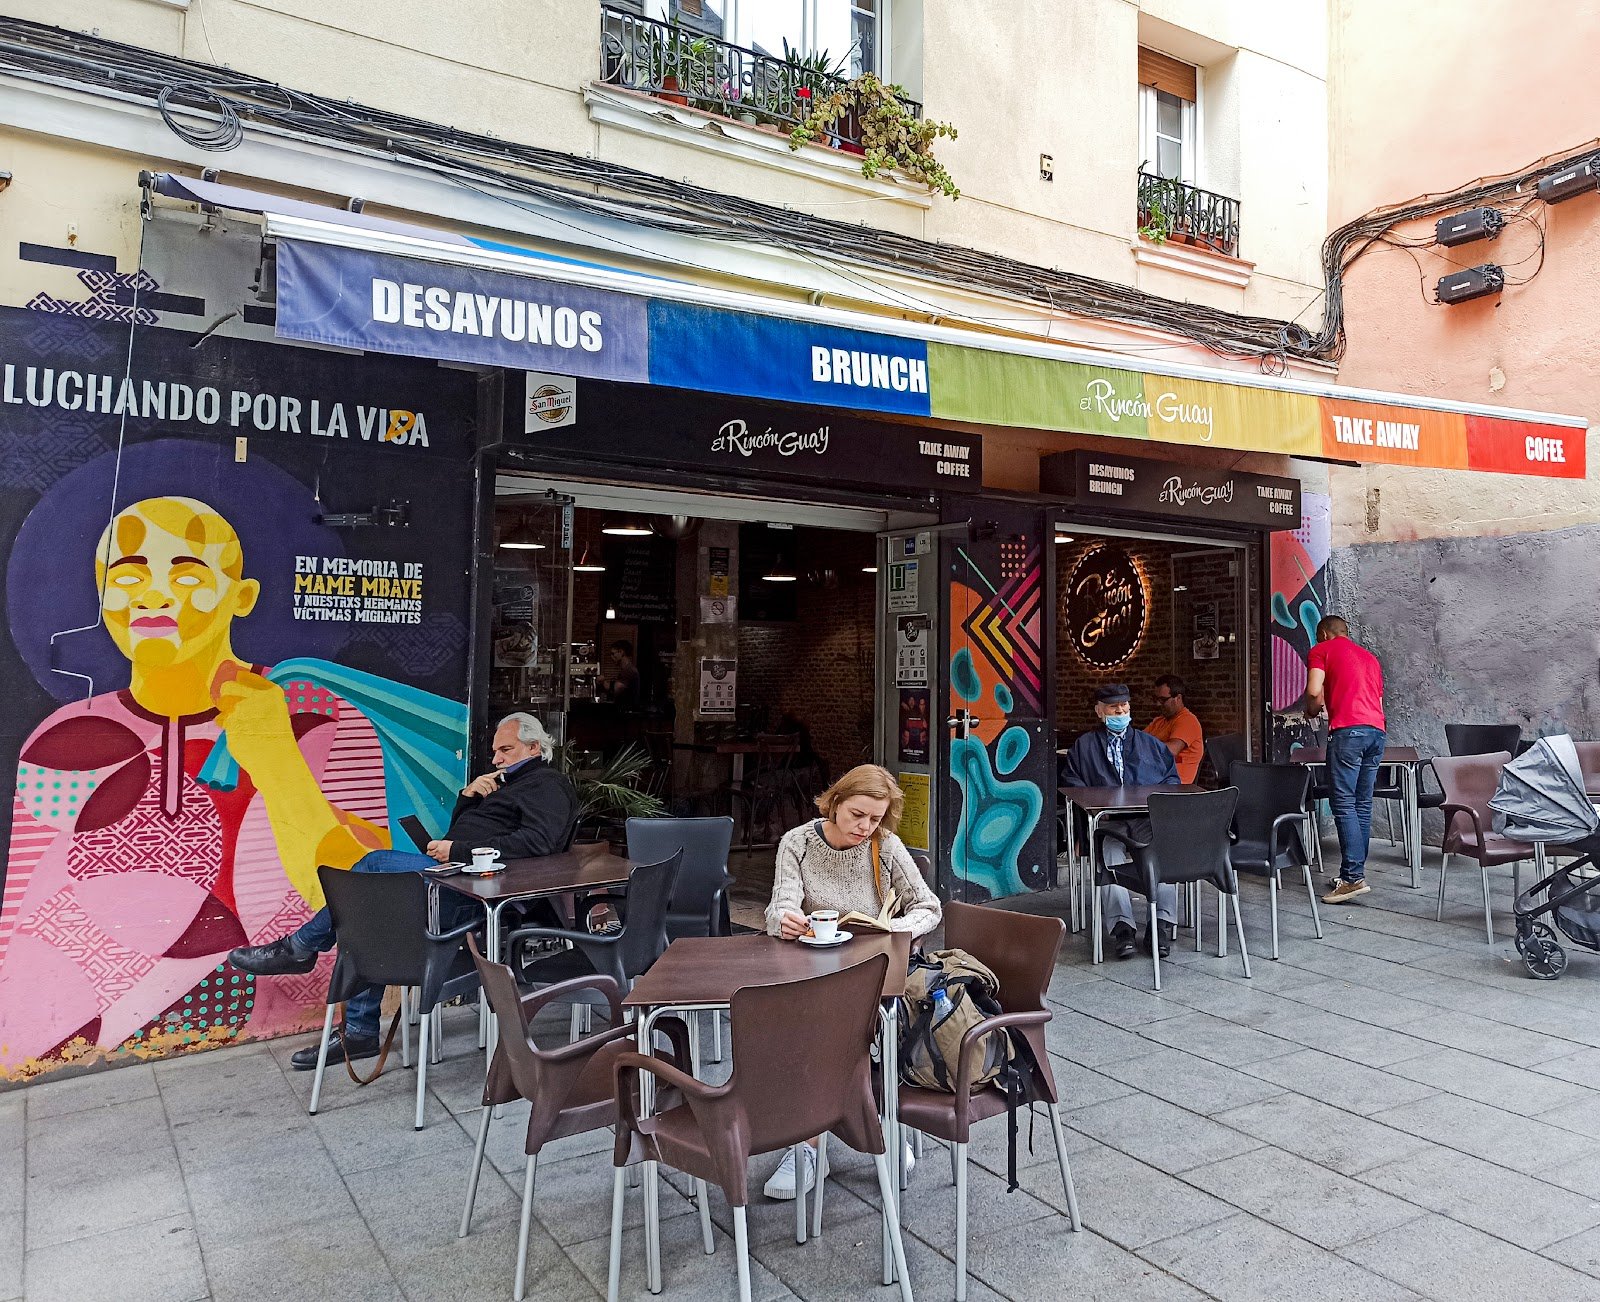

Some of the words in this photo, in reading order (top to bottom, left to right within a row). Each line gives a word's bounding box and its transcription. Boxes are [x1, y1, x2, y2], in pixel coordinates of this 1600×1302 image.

[372, 279, 603, 351] DESAYUNOS
[812, 346, 928, 393] BRUNCH
[4, 364, 220, 424] LUCHANDO
[230, 391, 301, 433] POR
[310, 400, 349, 438] LA
[530, 399, 547, 412] San
[547, 395, 571, 407] Miguel
[1079, 396, 1091, 411] El
[1086, 379, 1153, 422] Rincón
[1156, 392, 1213, 442] Guay
[711, 437, 725, 451] El
[719, 419, 780, 456] Rincón
[778, 426, 830, 456] Guay
[1332, 415, 1374, 446] TAKE
[1376, 421, 1420, 450] AWAY
[919, 440, 943, 456] TAKE
[943, 444, 970, 460] AWAY
[1525, 436, 1566, 463] COFEE
[936, 460, 970, 478] COFFEE
[1089, 463, 1135, 481] DESAYUNOS
[1089, 479, 1123, 496] BRUNCH
[1158, 492, 1168, 502] El
[1163, 475, 1201, 506] Rincón
[1199, 479, 1234, 505] Guay
[1257, 485, 1273, 499] TAKE
[1273, 488, 1293, 501] AWAY
[1269, 501, 1294, 515] COFFEE
[295, 556, 318, 574] EN
[322, 557, 399, 578] MEMORIA
[403, 563, 423, 579] DE
[294, 574, 356, 595] MAME
[361, 577, 422, 599] MBAYE
[293, 594, 301, 606] Y
[304, 595, 361, 609] NUESTRXS
[363, 597, 422, 612] HERMANXS
[355, 609, 421, 624] MIGRANTES
